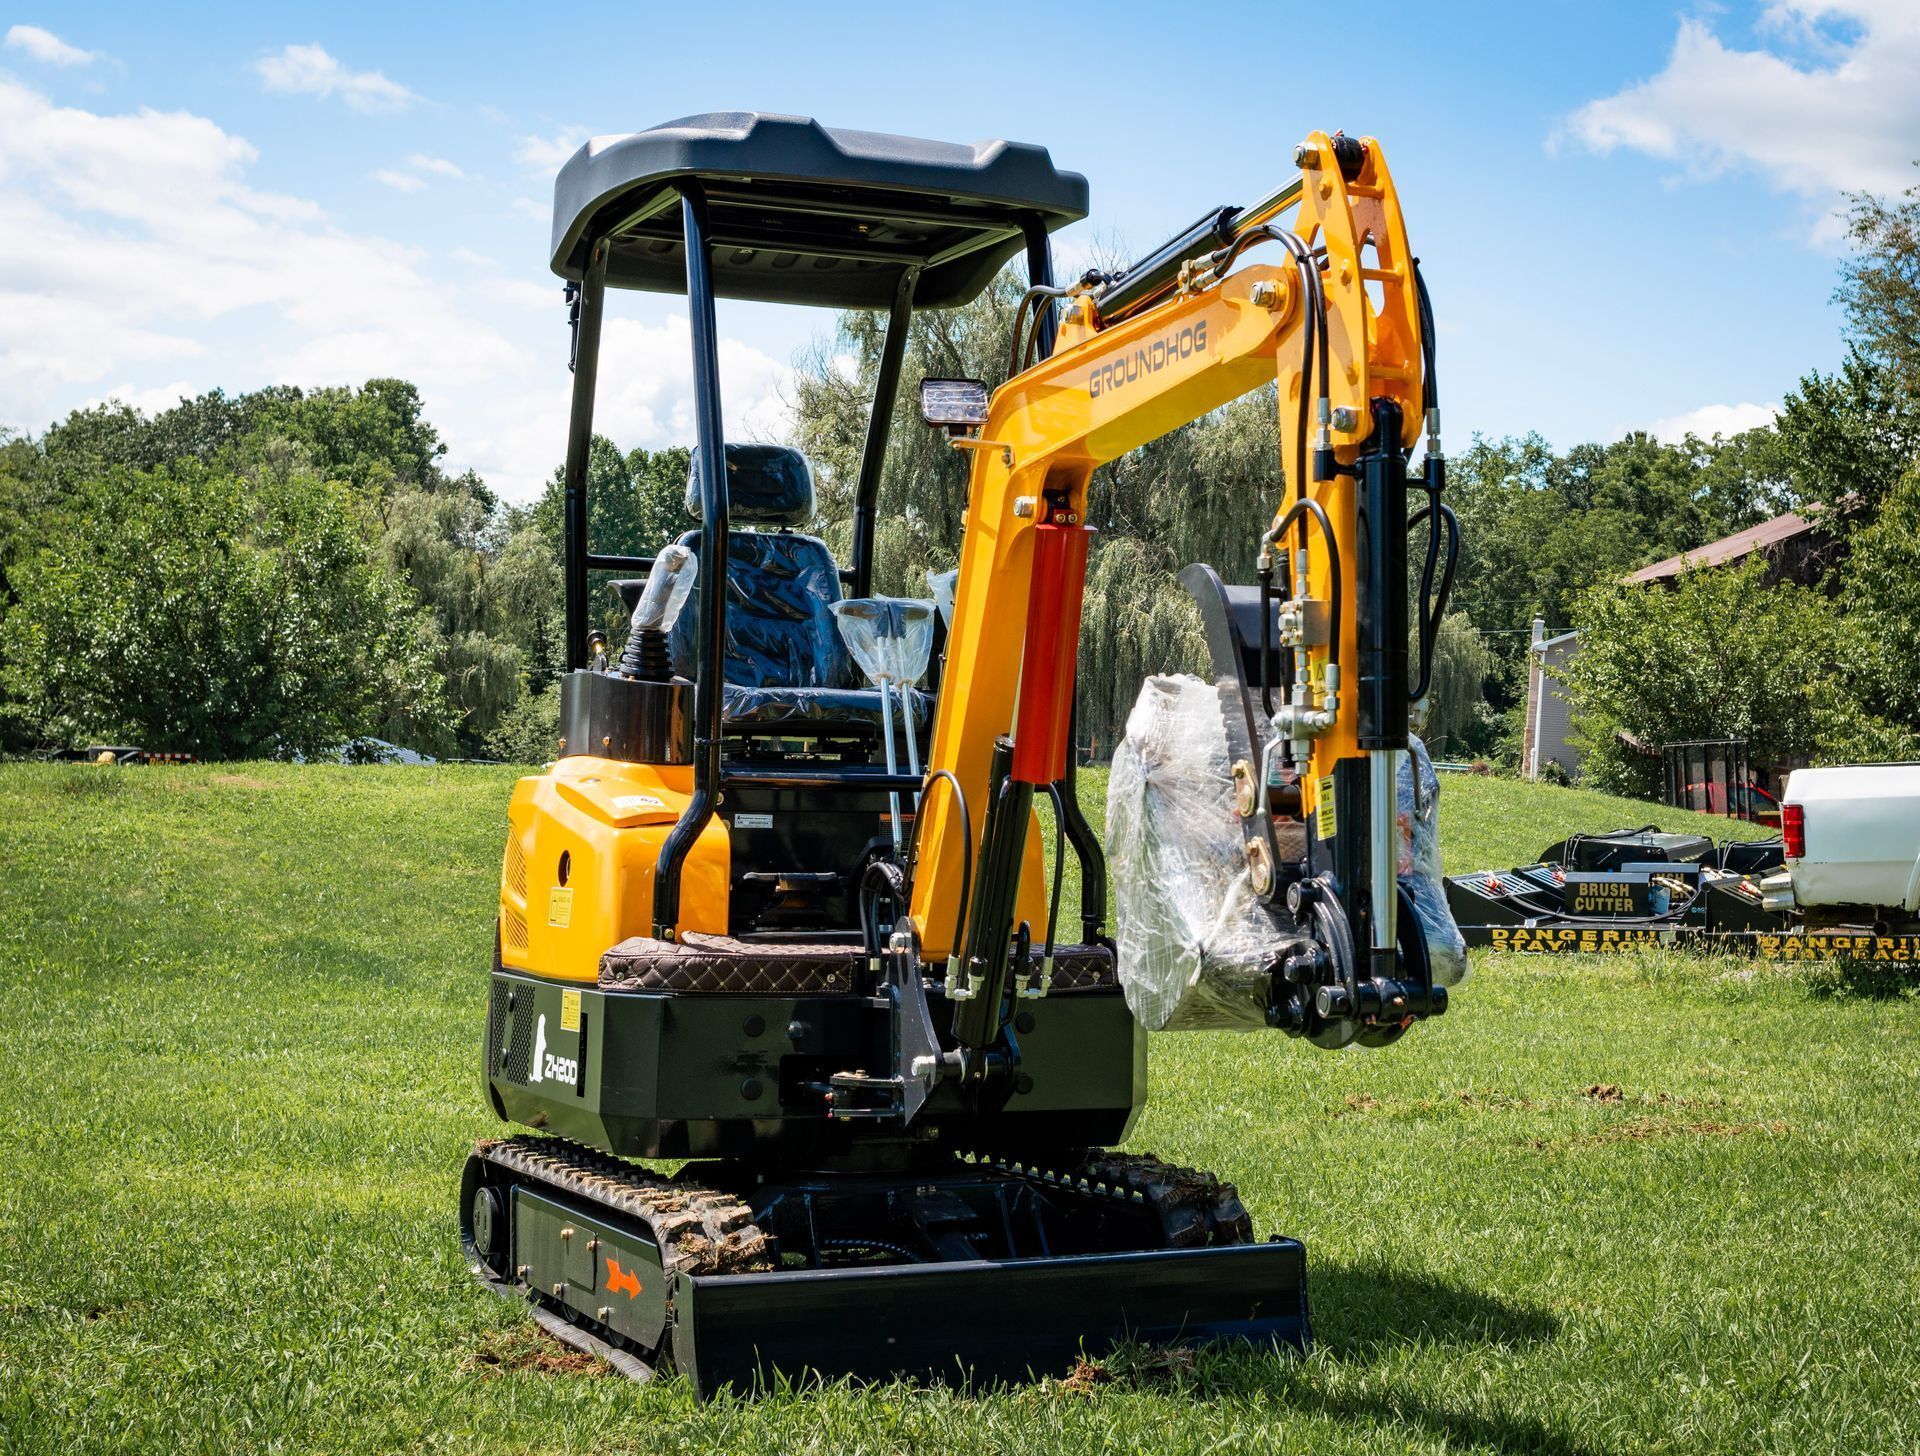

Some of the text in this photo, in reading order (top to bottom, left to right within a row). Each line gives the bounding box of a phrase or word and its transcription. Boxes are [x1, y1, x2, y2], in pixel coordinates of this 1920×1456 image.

[1089, 319, 1207, 399] GROUNDHOG
[1578, 882, 1630, 897] BRUSH
[1574, 896, 1634, 912] CUTTER
[1491, 929, 1657, 942] DANGER!!!
[1492, 939, 1564, 952] STAY
